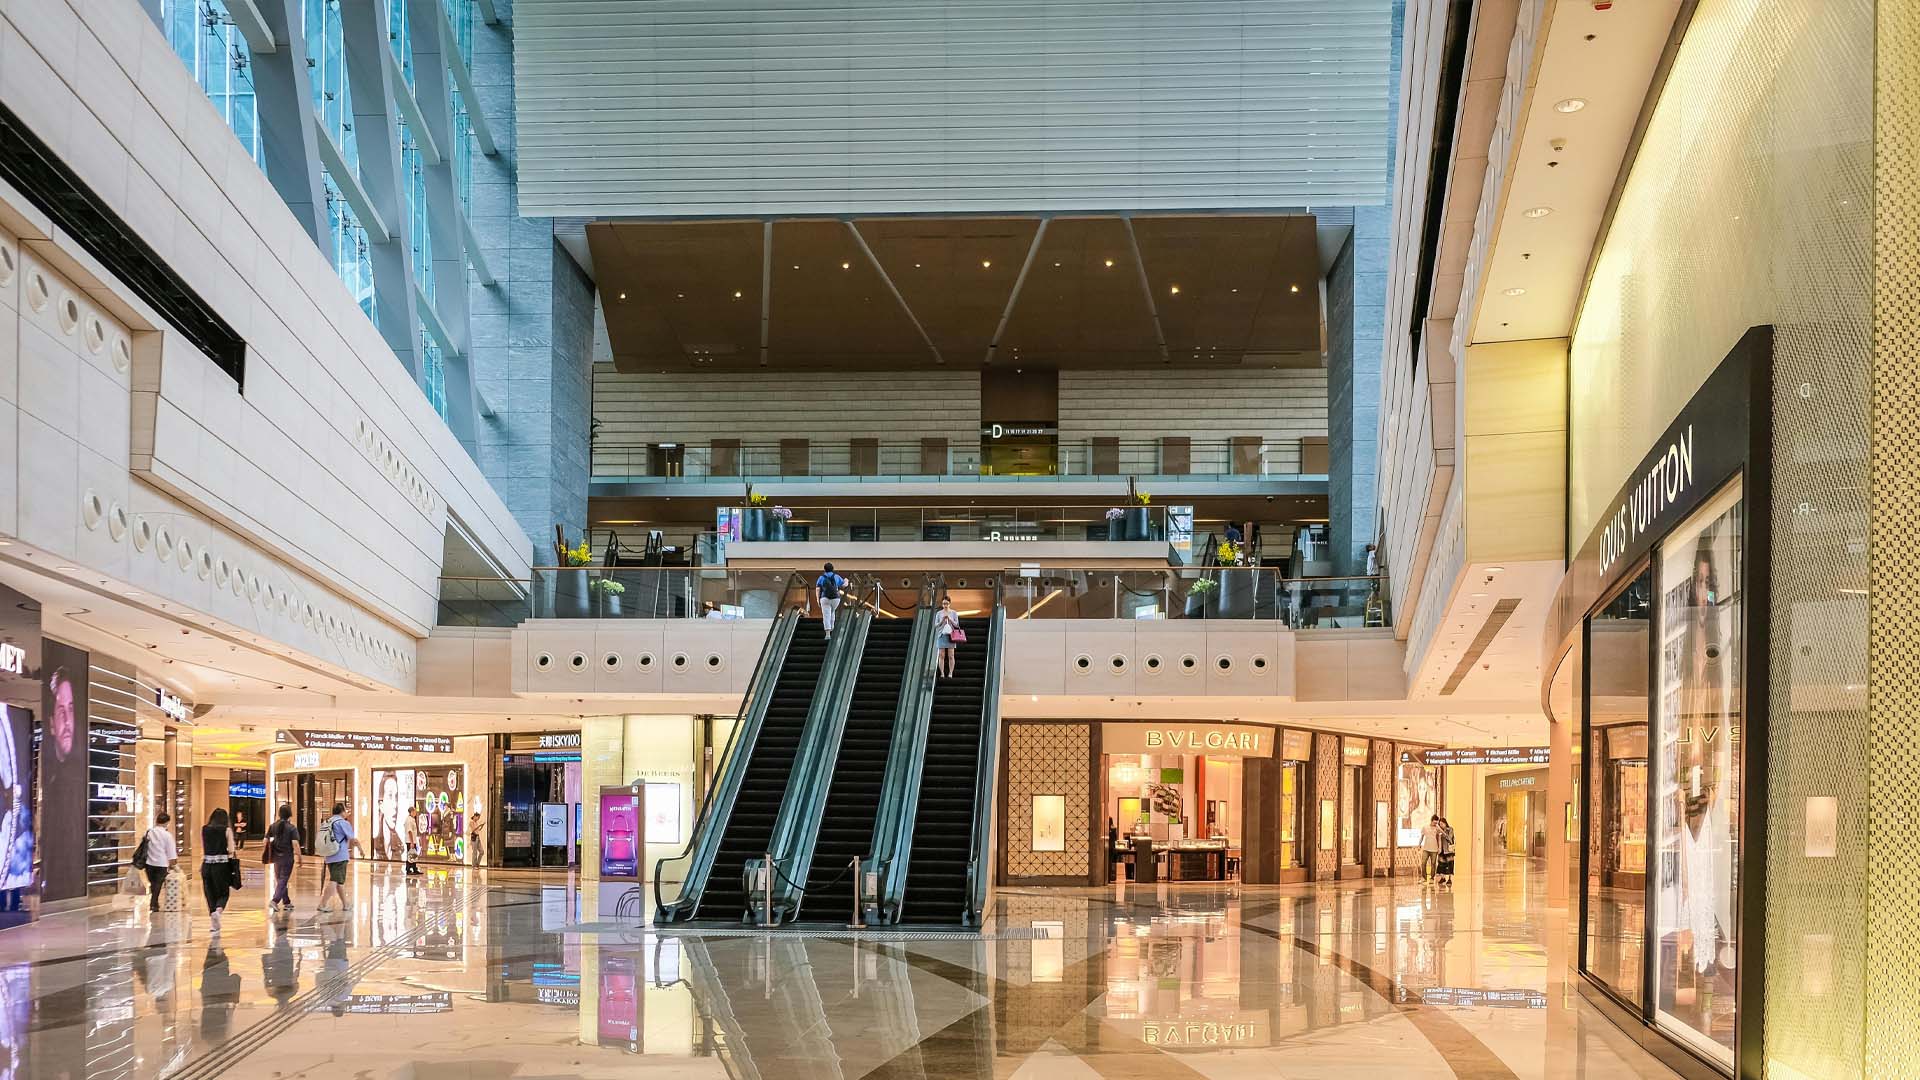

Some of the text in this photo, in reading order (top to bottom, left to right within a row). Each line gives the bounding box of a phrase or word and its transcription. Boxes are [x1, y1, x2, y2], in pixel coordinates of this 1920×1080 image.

[992, 424, 1003, 439] D
[1600, 424, 1693, 576] LOUIS VUITTON
[991, 531, 1001, 542] R
[554, 734, 580, 747] SKY100
[1146, 731, 1260, 750] BVLGARI
